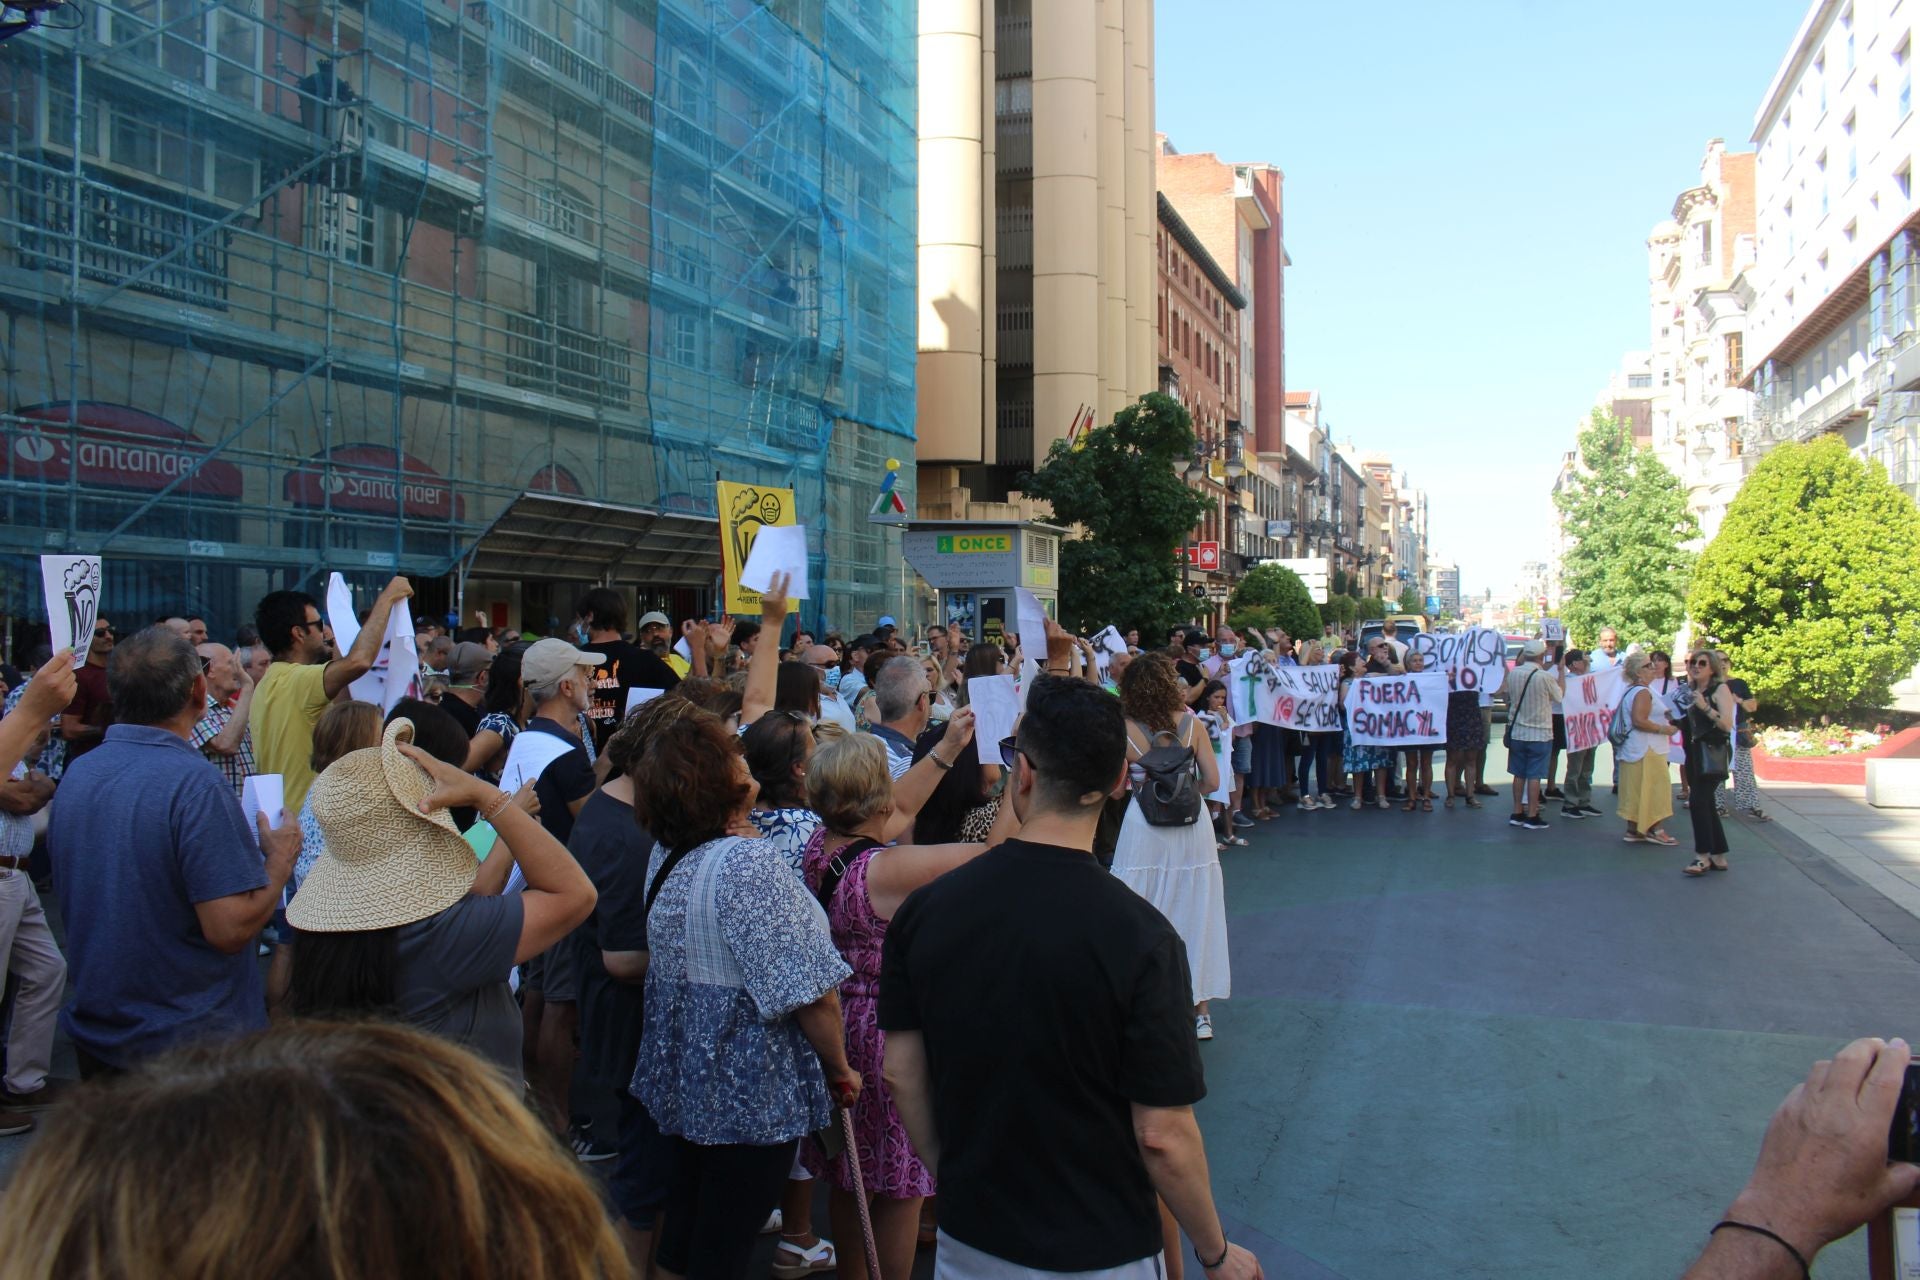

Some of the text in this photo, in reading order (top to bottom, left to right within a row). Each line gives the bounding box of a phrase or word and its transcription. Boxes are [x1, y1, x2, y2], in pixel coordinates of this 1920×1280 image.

[60, 438, 202, 478] Santander
[959, 537, 1006, 550] ONCE
[1359, 680, 1421, 704] FUERA
[1353, 707, 1439, 739] SOMACYL
